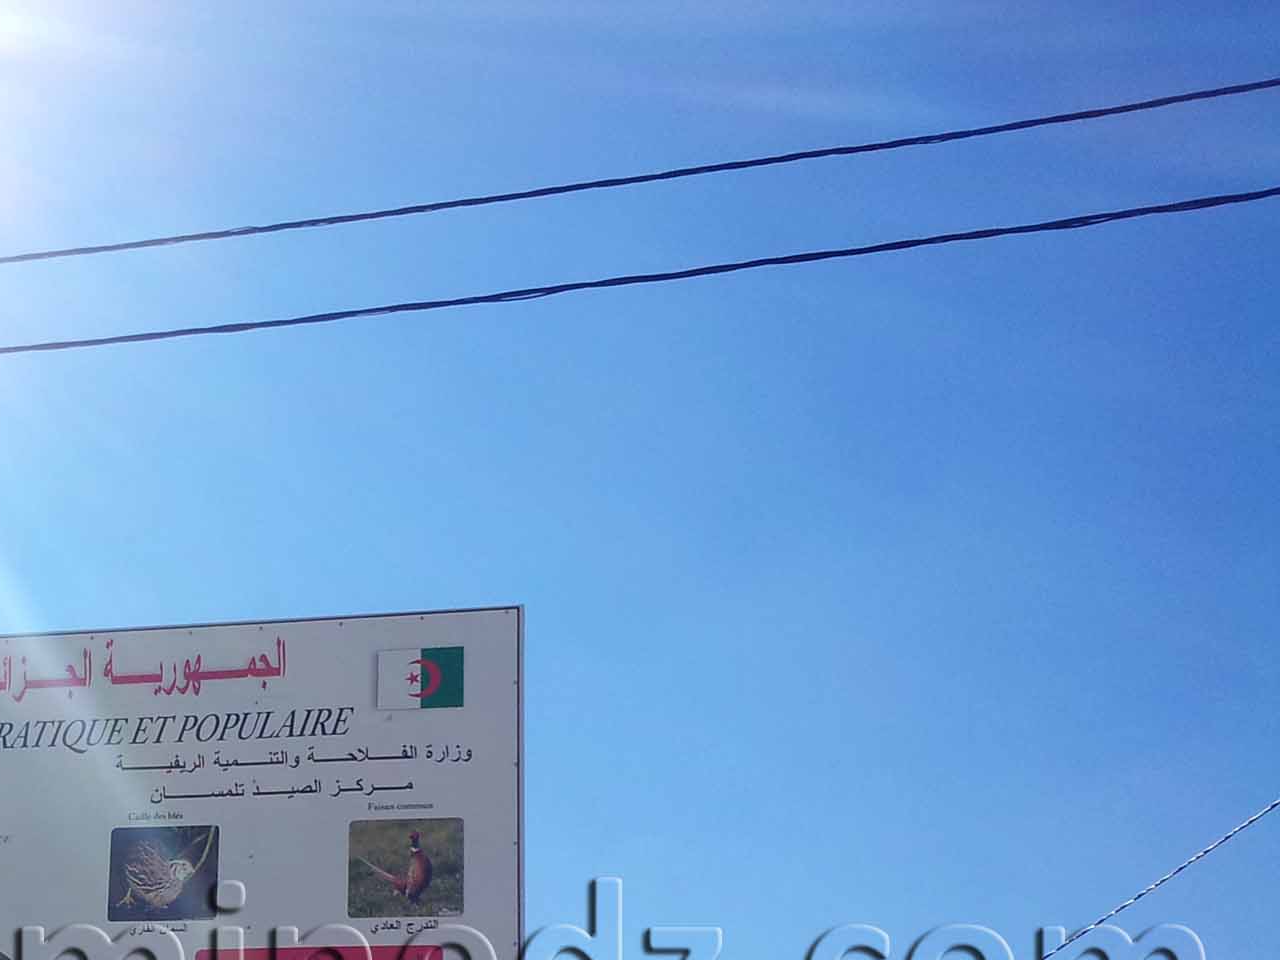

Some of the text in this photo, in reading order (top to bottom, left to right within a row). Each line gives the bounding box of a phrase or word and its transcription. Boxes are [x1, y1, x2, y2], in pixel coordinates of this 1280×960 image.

[104, 636, 286, 697] الجمهورية
[129, 715, 169, 744] ET
[176, 706, 355, 743] POPULAIRE
[116, 743, 473, 773] وزارة الفلاحة والتنمية الريفية
[150, 777, 414, 804] مركز الصيد تلمسان
